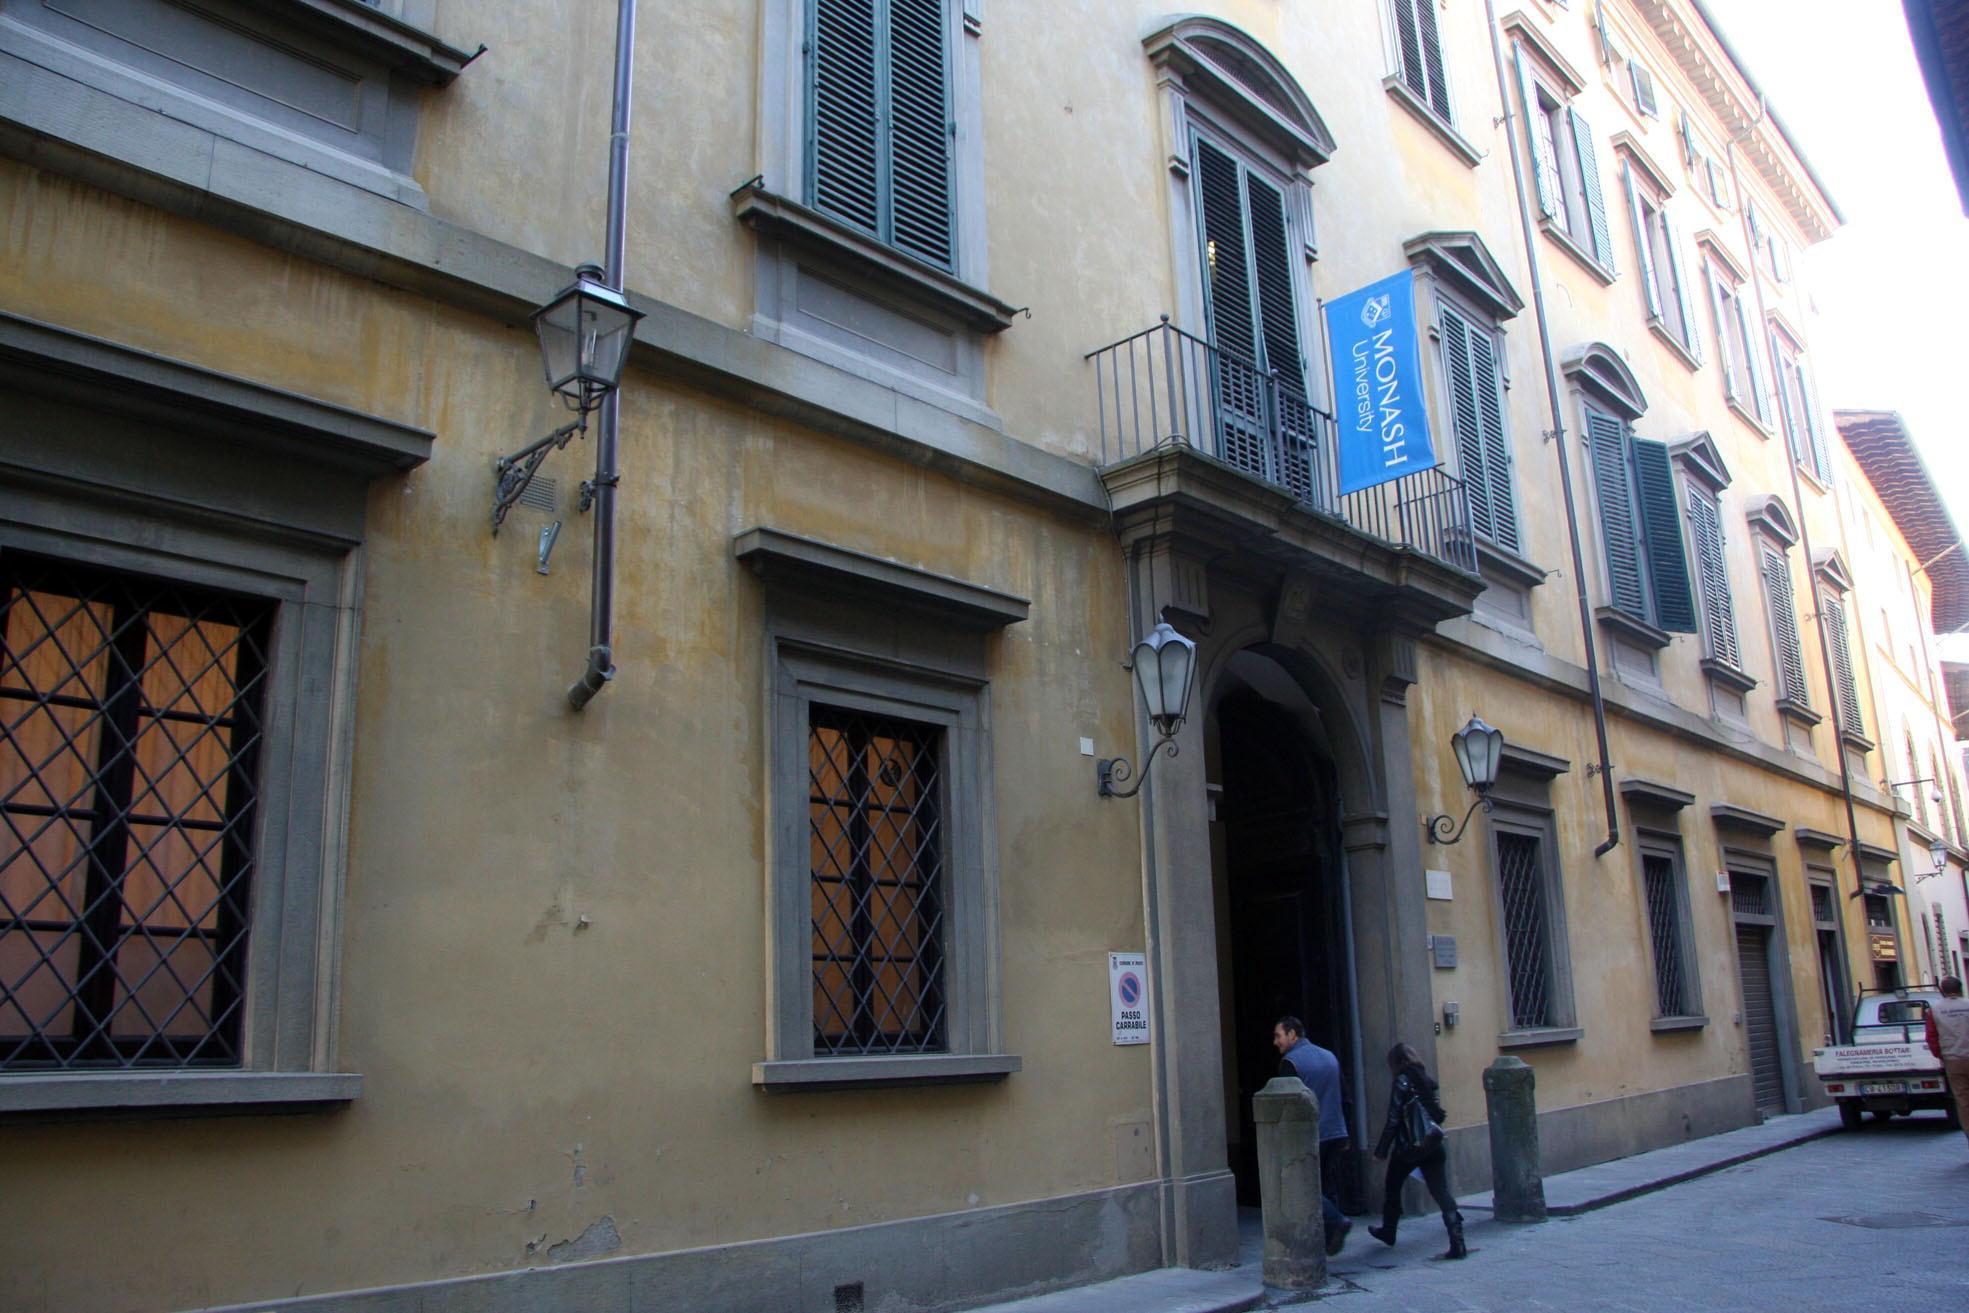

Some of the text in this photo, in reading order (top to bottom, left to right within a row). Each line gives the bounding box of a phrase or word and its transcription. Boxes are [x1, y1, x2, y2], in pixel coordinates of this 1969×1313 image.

[1352, 339, 1376, 433] University
[1372, 328, 1408, 467] MONASH
[1115, 1020, 1147, 1031] CARRABILE
[1121, 1011, 1141, 1020] PASSO
